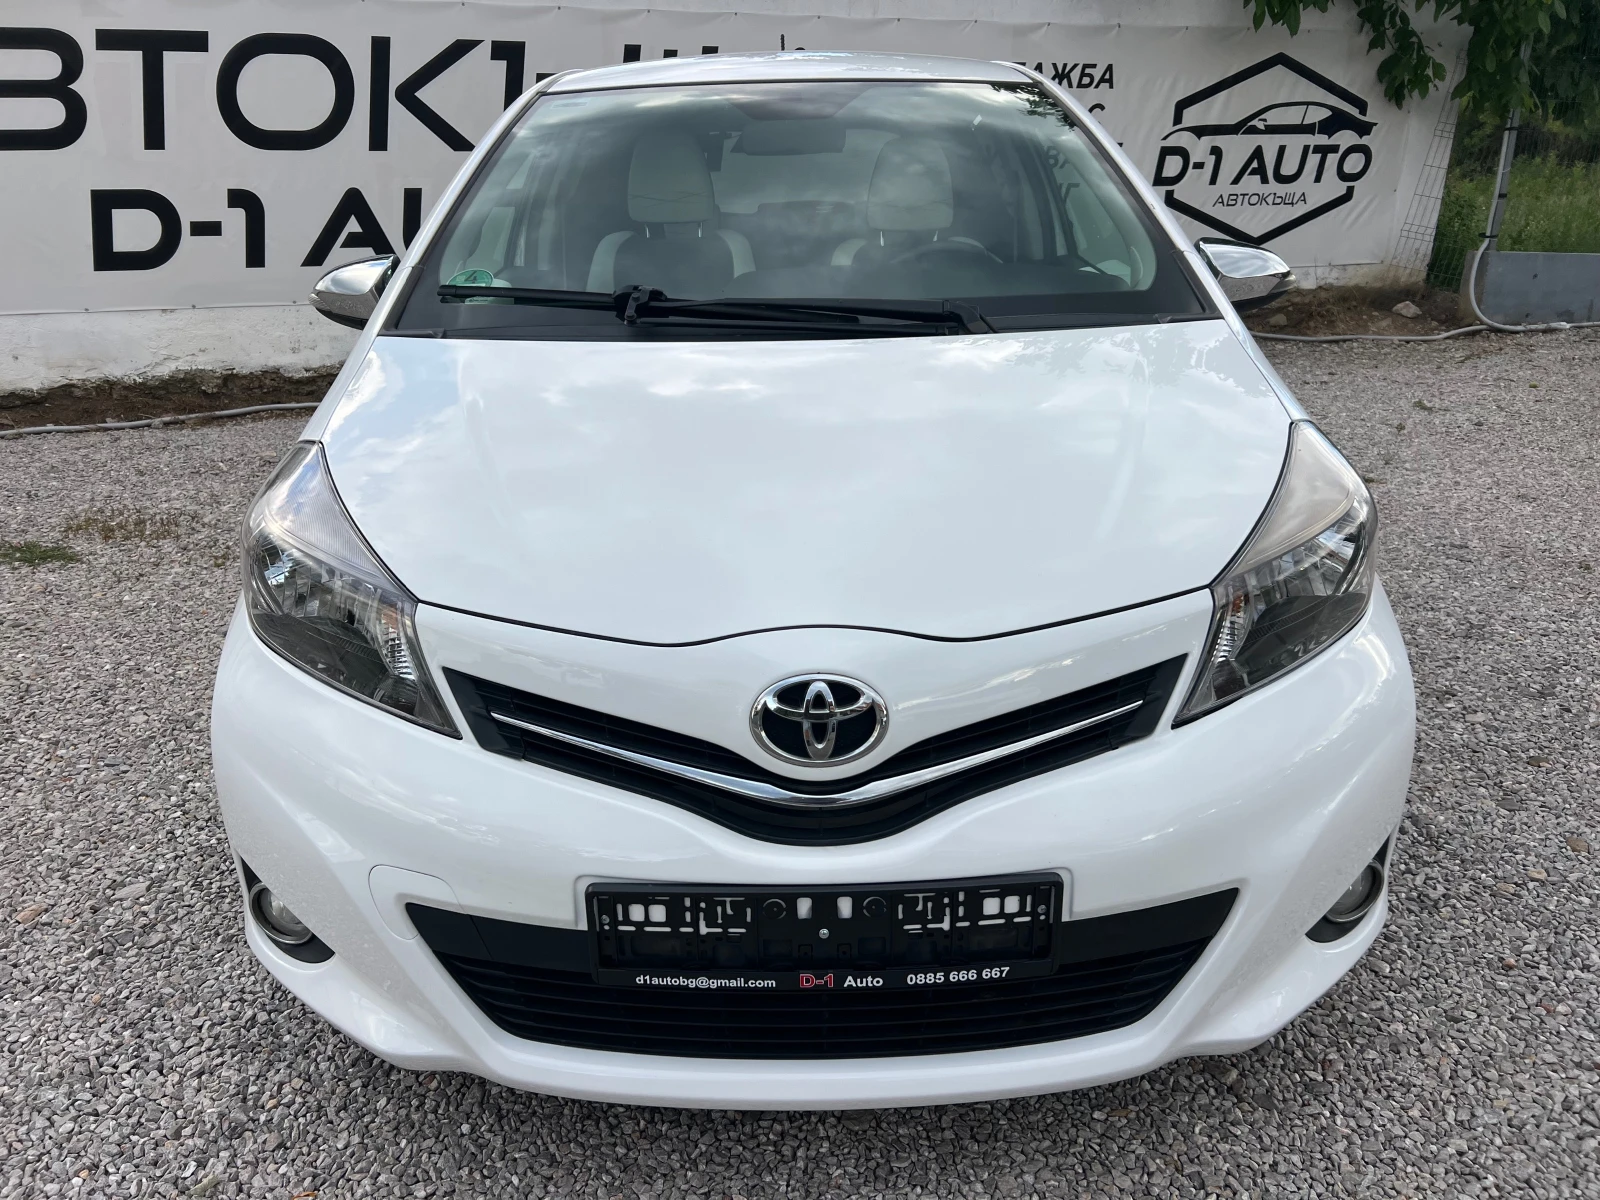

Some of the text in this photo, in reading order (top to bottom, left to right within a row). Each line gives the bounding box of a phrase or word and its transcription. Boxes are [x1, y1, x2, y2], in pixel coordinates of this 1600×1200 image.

[1152, 143, 1373, 186] D-1 AUTO
[1212, 191, 1307, 207] АВТОКЪЩА
[90, 187, 266, 272] D-1
[635, 966, 1010, 989] d1autobg@gmail.com D-1 Auto 0885 666 667
